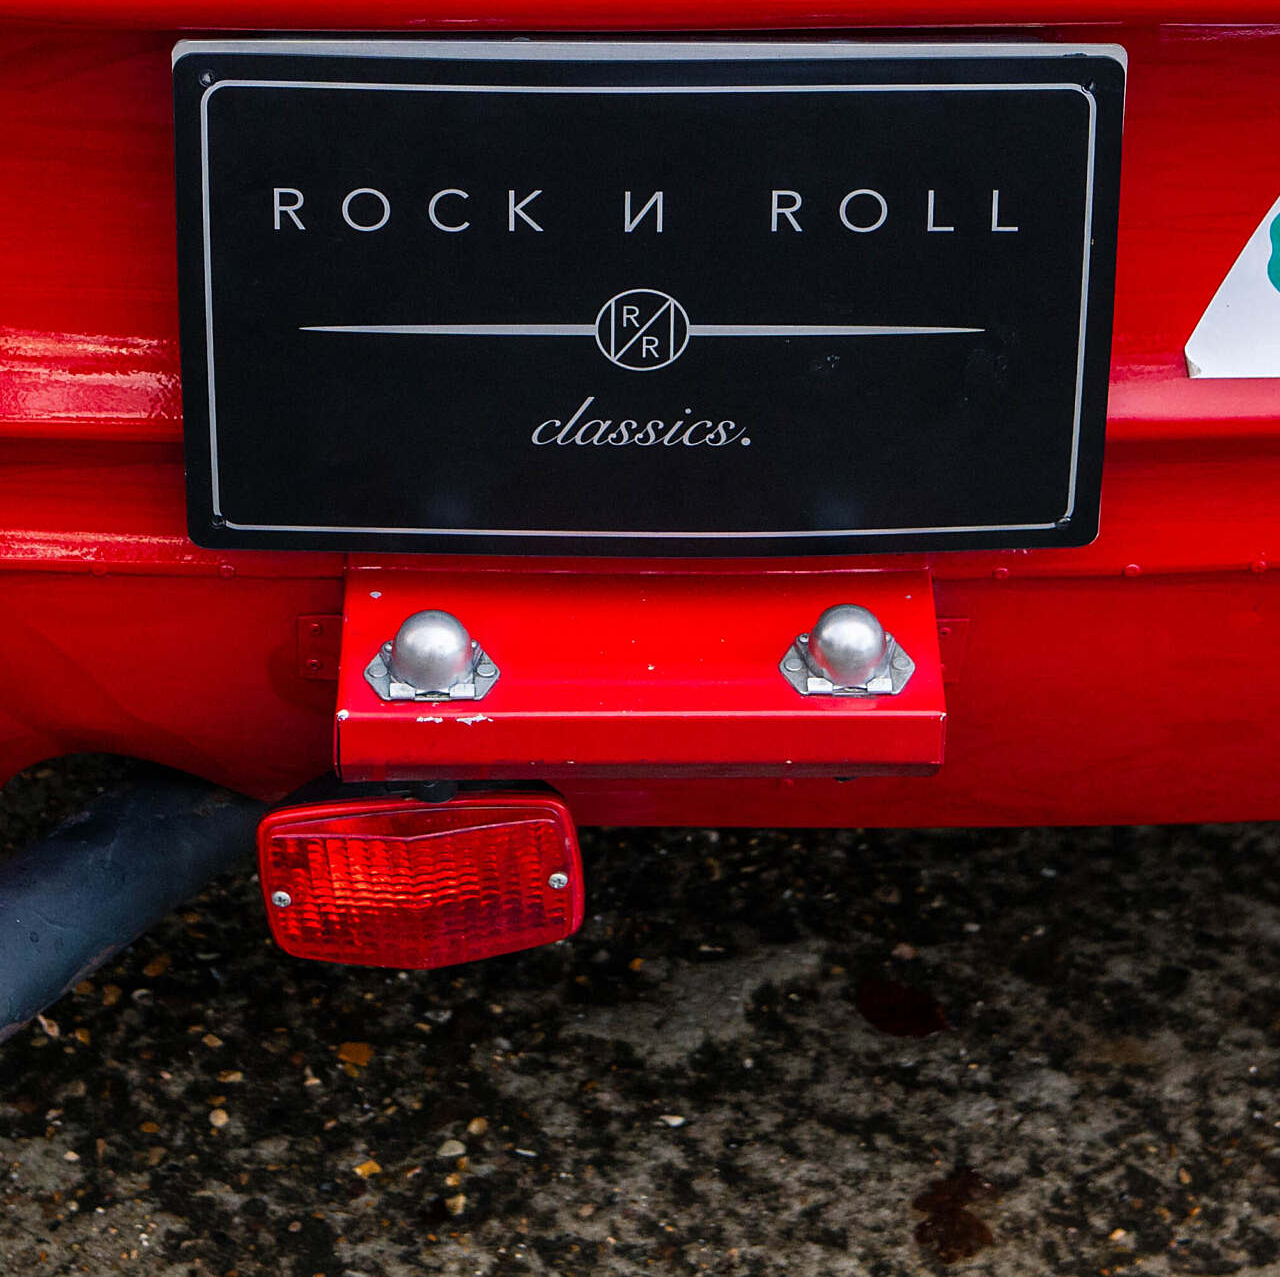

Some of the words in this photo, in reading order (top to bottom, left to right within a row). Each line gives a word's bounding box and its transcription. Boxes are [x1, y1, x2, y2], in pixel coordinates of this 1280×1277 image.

[273, 186, 544, 233] ROCK
[771, 188, 1020, 233] ROLL
[531, 396, 752, 447] classics.
